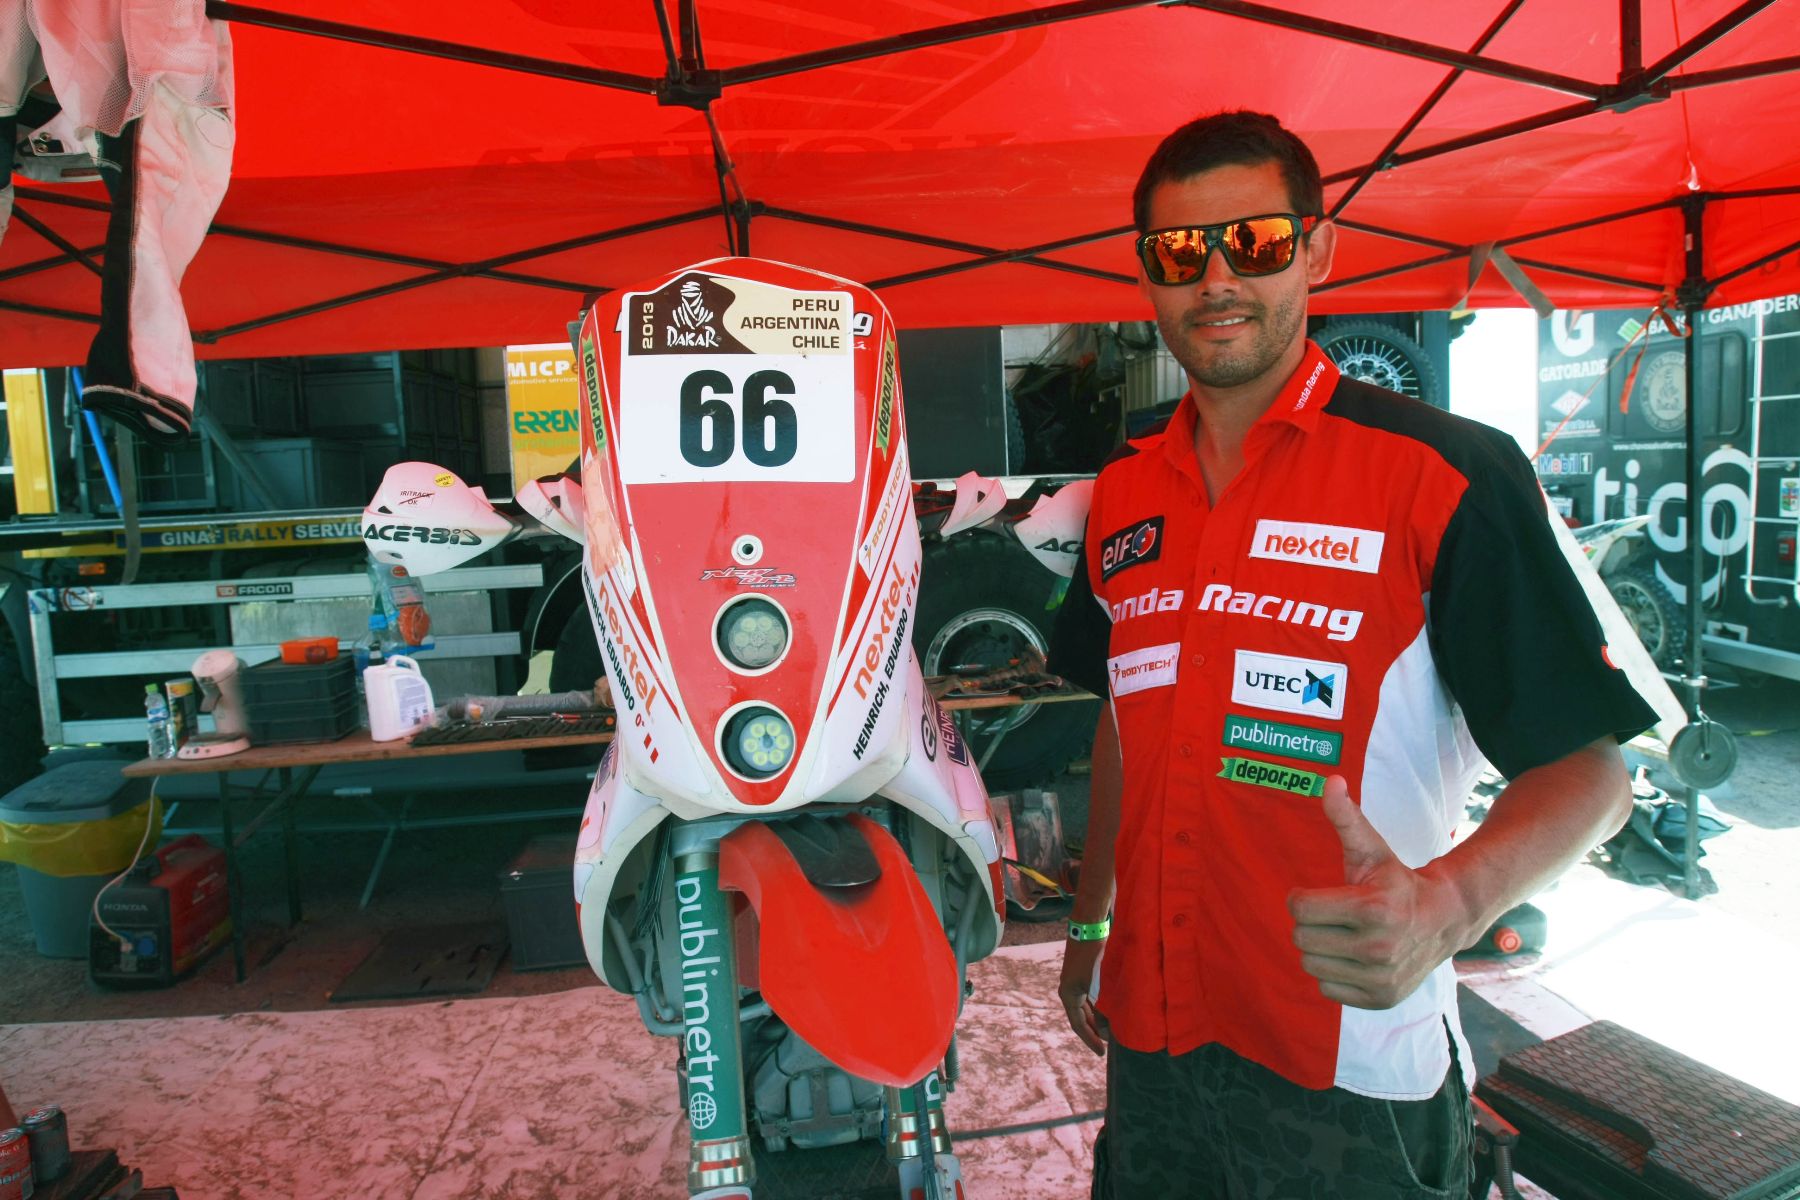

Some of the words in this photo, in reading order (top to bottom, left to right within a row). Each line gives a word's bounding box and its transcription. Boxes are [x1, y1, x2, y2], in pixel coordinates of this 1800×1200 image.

[792, 298, 840, 312] PERU
[1708, 293, 1800, 324] GANADER
[642, 302, 654, 349] 2013
[666, 325, 720, 348] DAKAR
[740, 316, 840, 330] ARGENTINA
[792, 335, 840, 349] CHILE
[1539, 358, 1608, 383] GATORADE
[585, 352, 604, 442] depor.pe
[880, 350, 895, 438] depor.pe
[680, 369, 798, 468] 66
[1540, 454, 1579, 474] Mobil
[228, 526, 288, 543] RALLY
[1264, 534, 1360, 564] nextel
[1102, 533, 1133, 571] elf
[237, 583, 293, 595] FACOM
[1197, 583, 1364, 642] Racing
[583, 566, 606, 643] HEINRICH,
[606, 641, 635, 711] EDUARDO
[854, 561, 906, 701] nextel
[599, 580, 658, 717] nextel
[852, 683, 890, 761] HEINRICH,
[885, 608, 908, 680] EDUARDO
[1121, 661, 1171, 679] BODYTECH
[1245, 670, 1302, 694] UTEC
[1230, 722, 1333, 757] publimetro
[1235, 760, 1312, 790] depor.pe
[104, 903, 149, 912] HONDA
[675, 876, 721, 1130] publimetro
